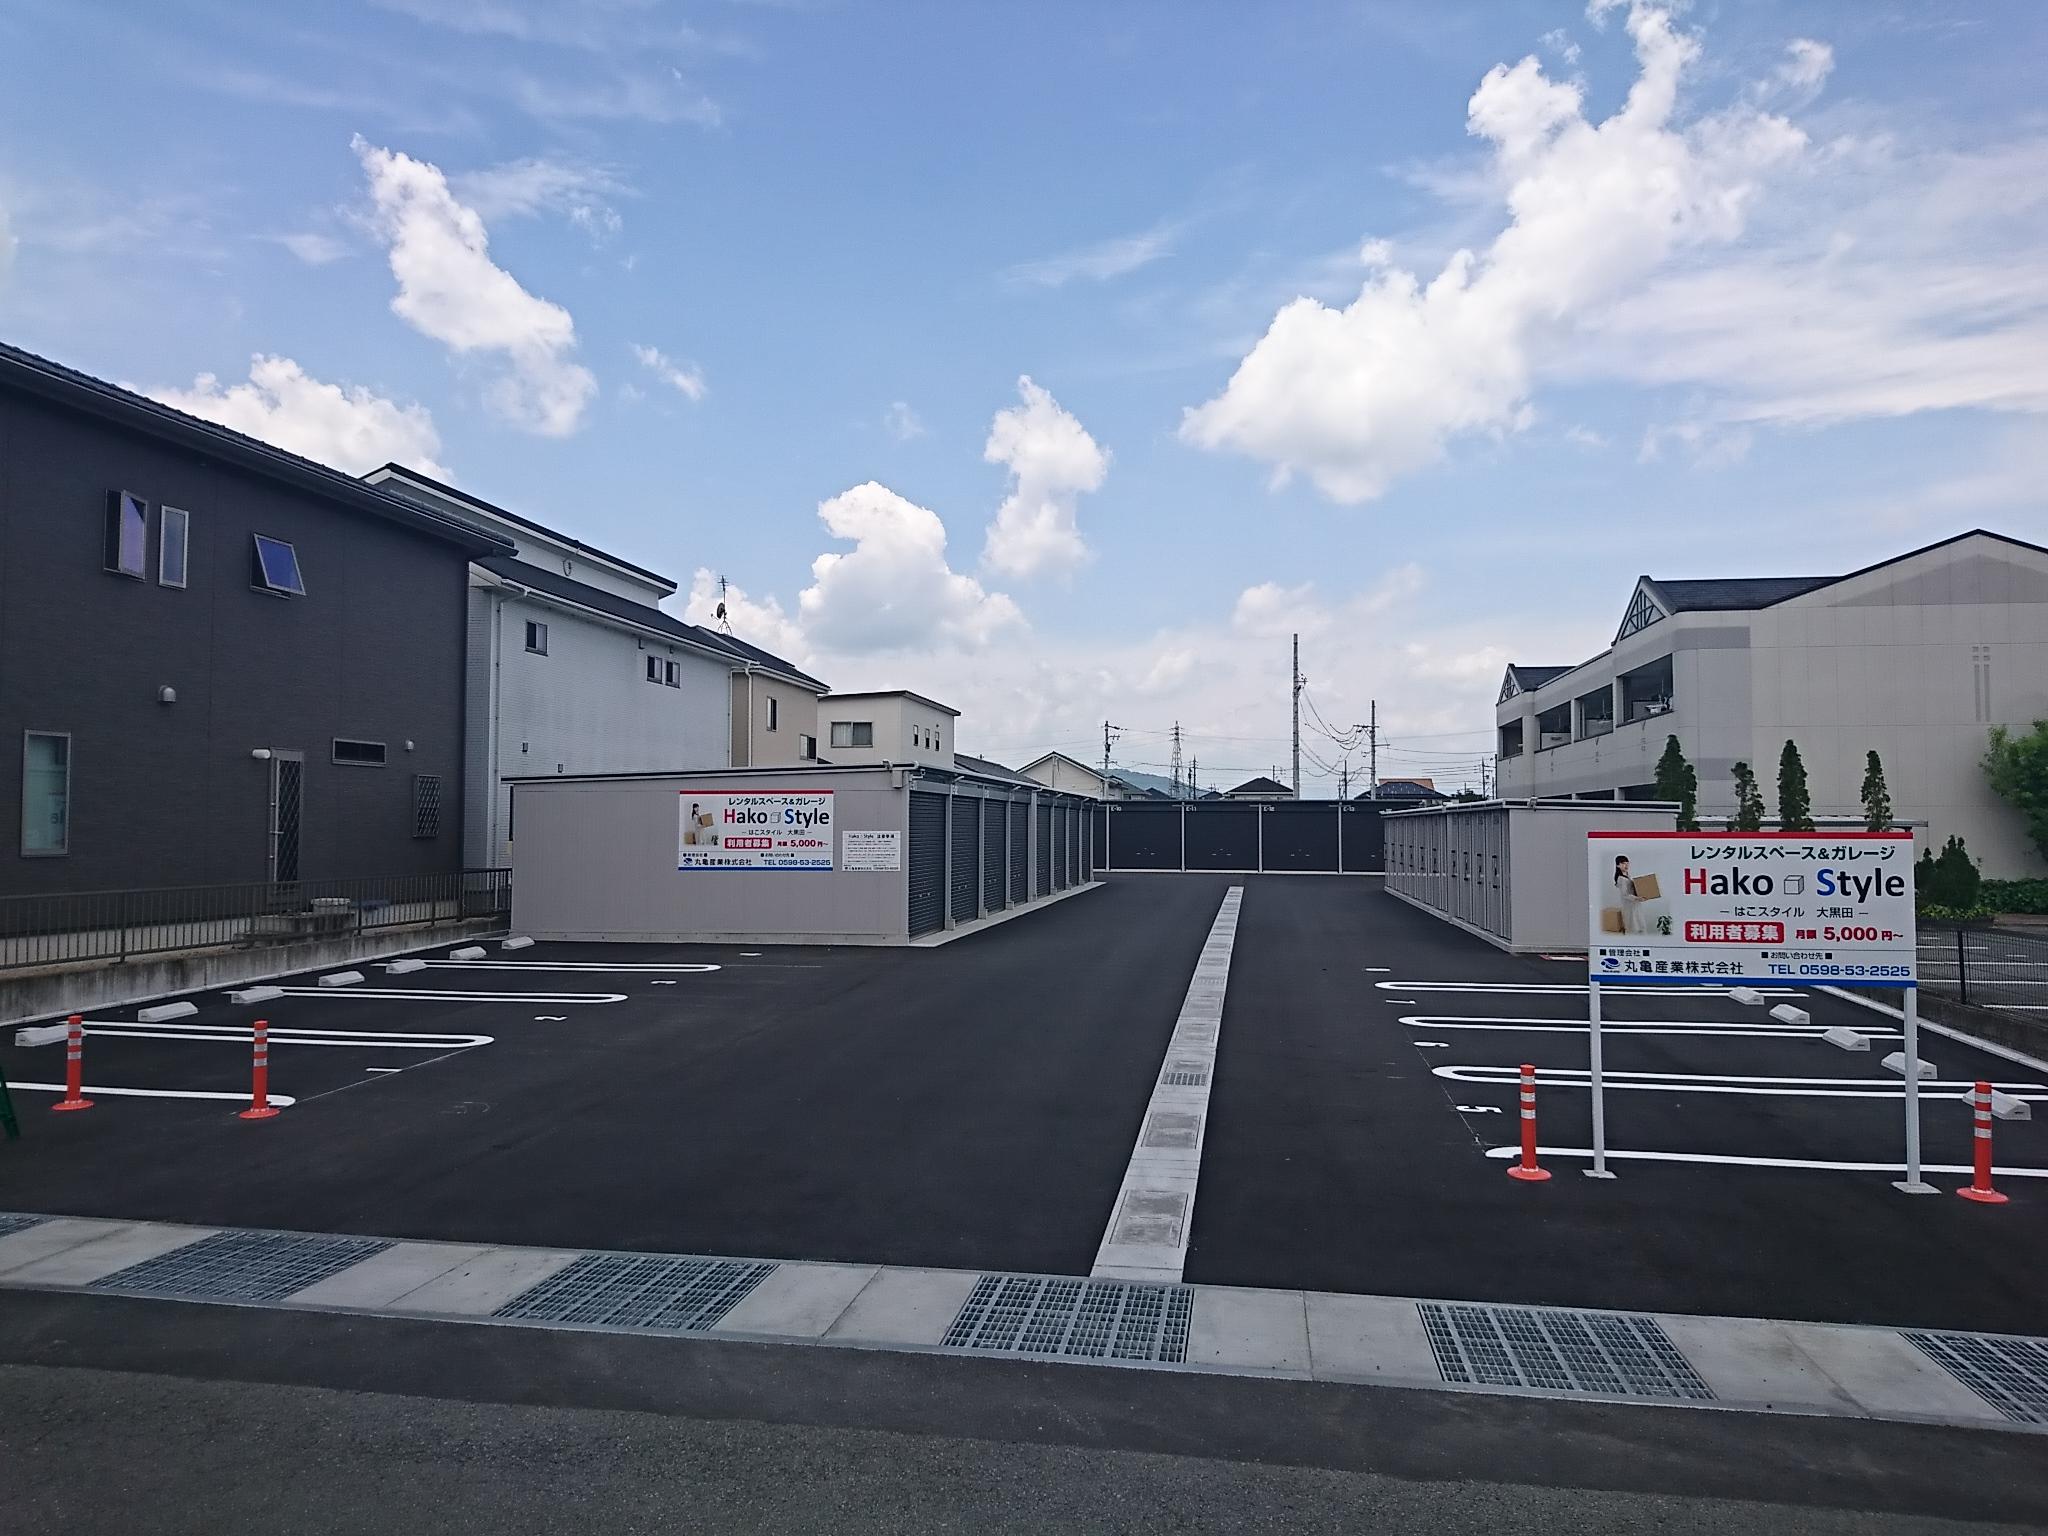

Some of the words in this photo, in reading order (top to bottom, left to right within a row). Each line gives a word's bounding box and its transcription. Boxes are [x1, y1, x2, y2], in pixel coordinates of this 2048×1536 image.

[724, 808, 767, 824] Hako
[784, 808, 829, 828] Style
[1690, 845, 1896, 861] レンタルスペース&ガレージ
[1684, 867, 1773, 896] Hako
[1817, 867, 1904, 903] Style
[1734, 906, 1805, 918] はこスタイル
[1816, 906, 1854, 918] 大黒田
[1690, 923, 1780, 941] 利用者募集
[1769, 952, 1823, 961] お問い合わせ先
[1624, 959, 1744, 975] 丸亀産業株式会社
[1768, 963, 1795, 975] TEL
[1799, 965, 1911, 977] 0598-53-2525
